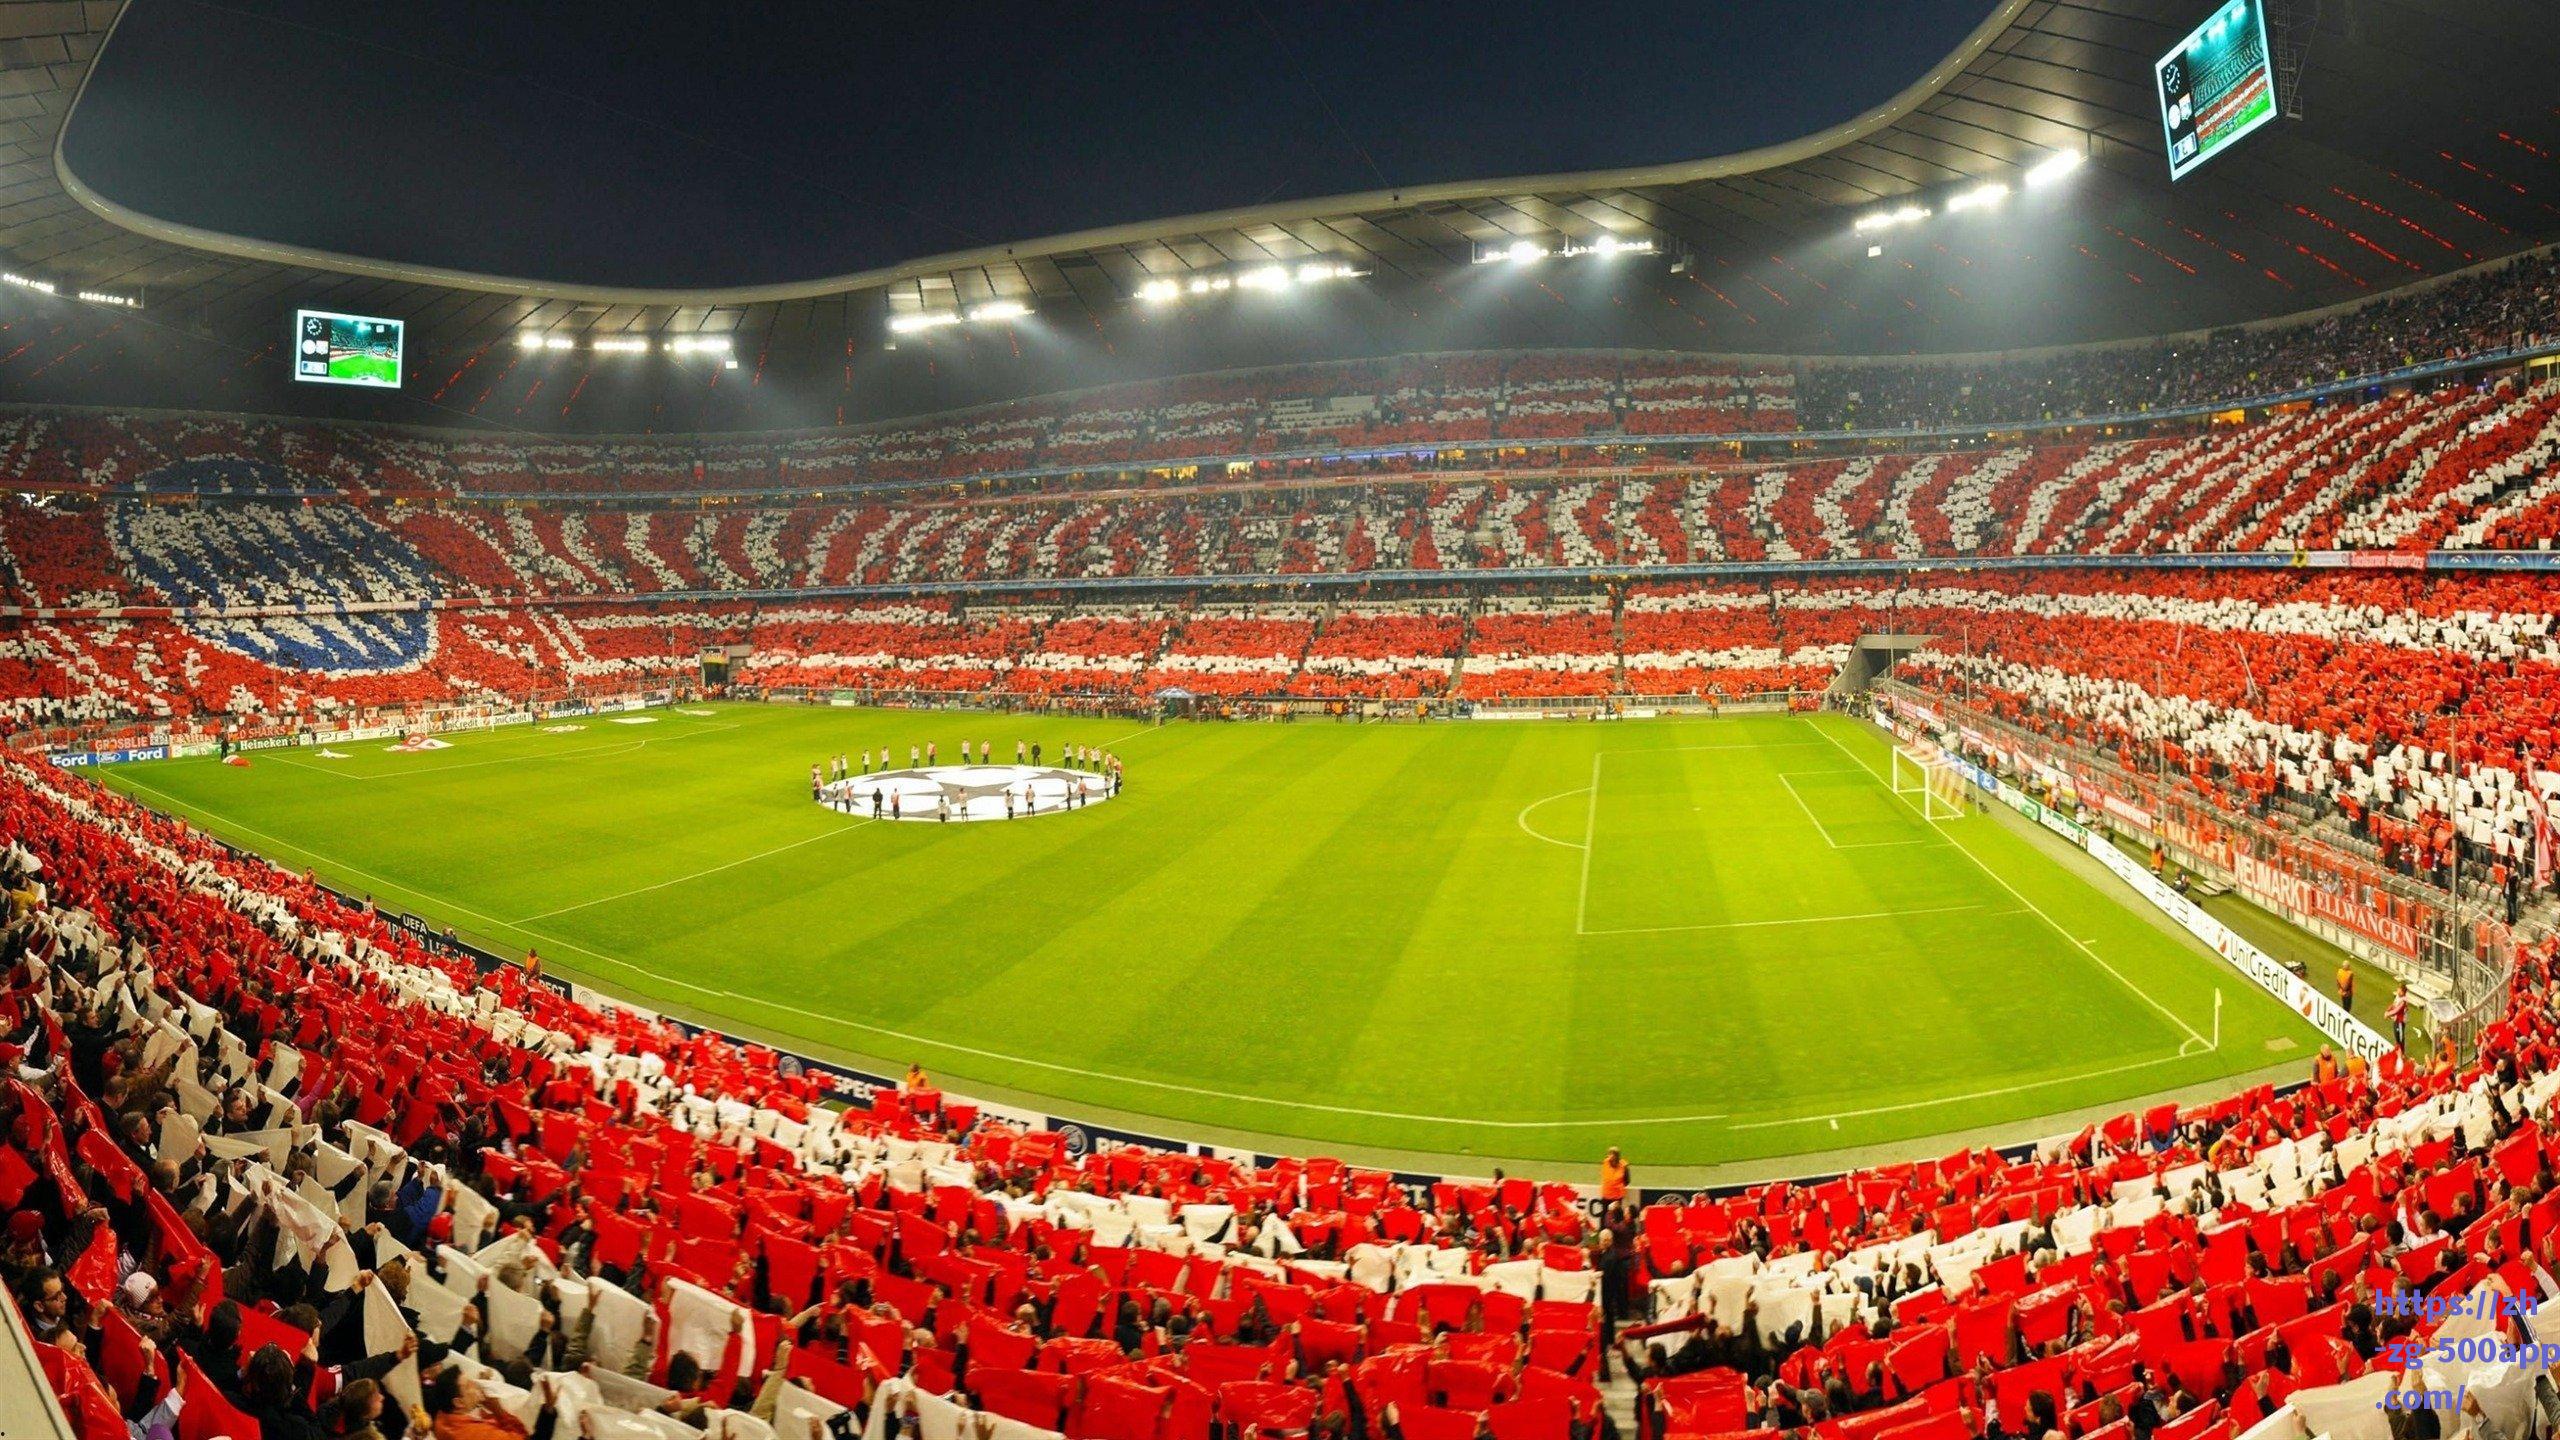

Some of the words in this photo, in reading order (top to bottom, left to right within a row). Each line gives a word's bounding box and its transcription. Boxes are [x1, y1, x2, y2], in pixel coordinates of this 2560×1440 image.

[249, 725, 287, 739] SHARKS
[240, 737, 289, 751] Heineken
[52, 754, 88, 768] Ford
[128, 747, 163, 762] Ford
[2235, 851, 2312, 915] NEUMARKT
[402, 915, 428, 935] UEFA
[2315, 890, 2415, 953] ELLWANGEN
[2229, 934, 2290, 1000] UniCredit
[2316, 996, 2391, 1062] UniCredi
